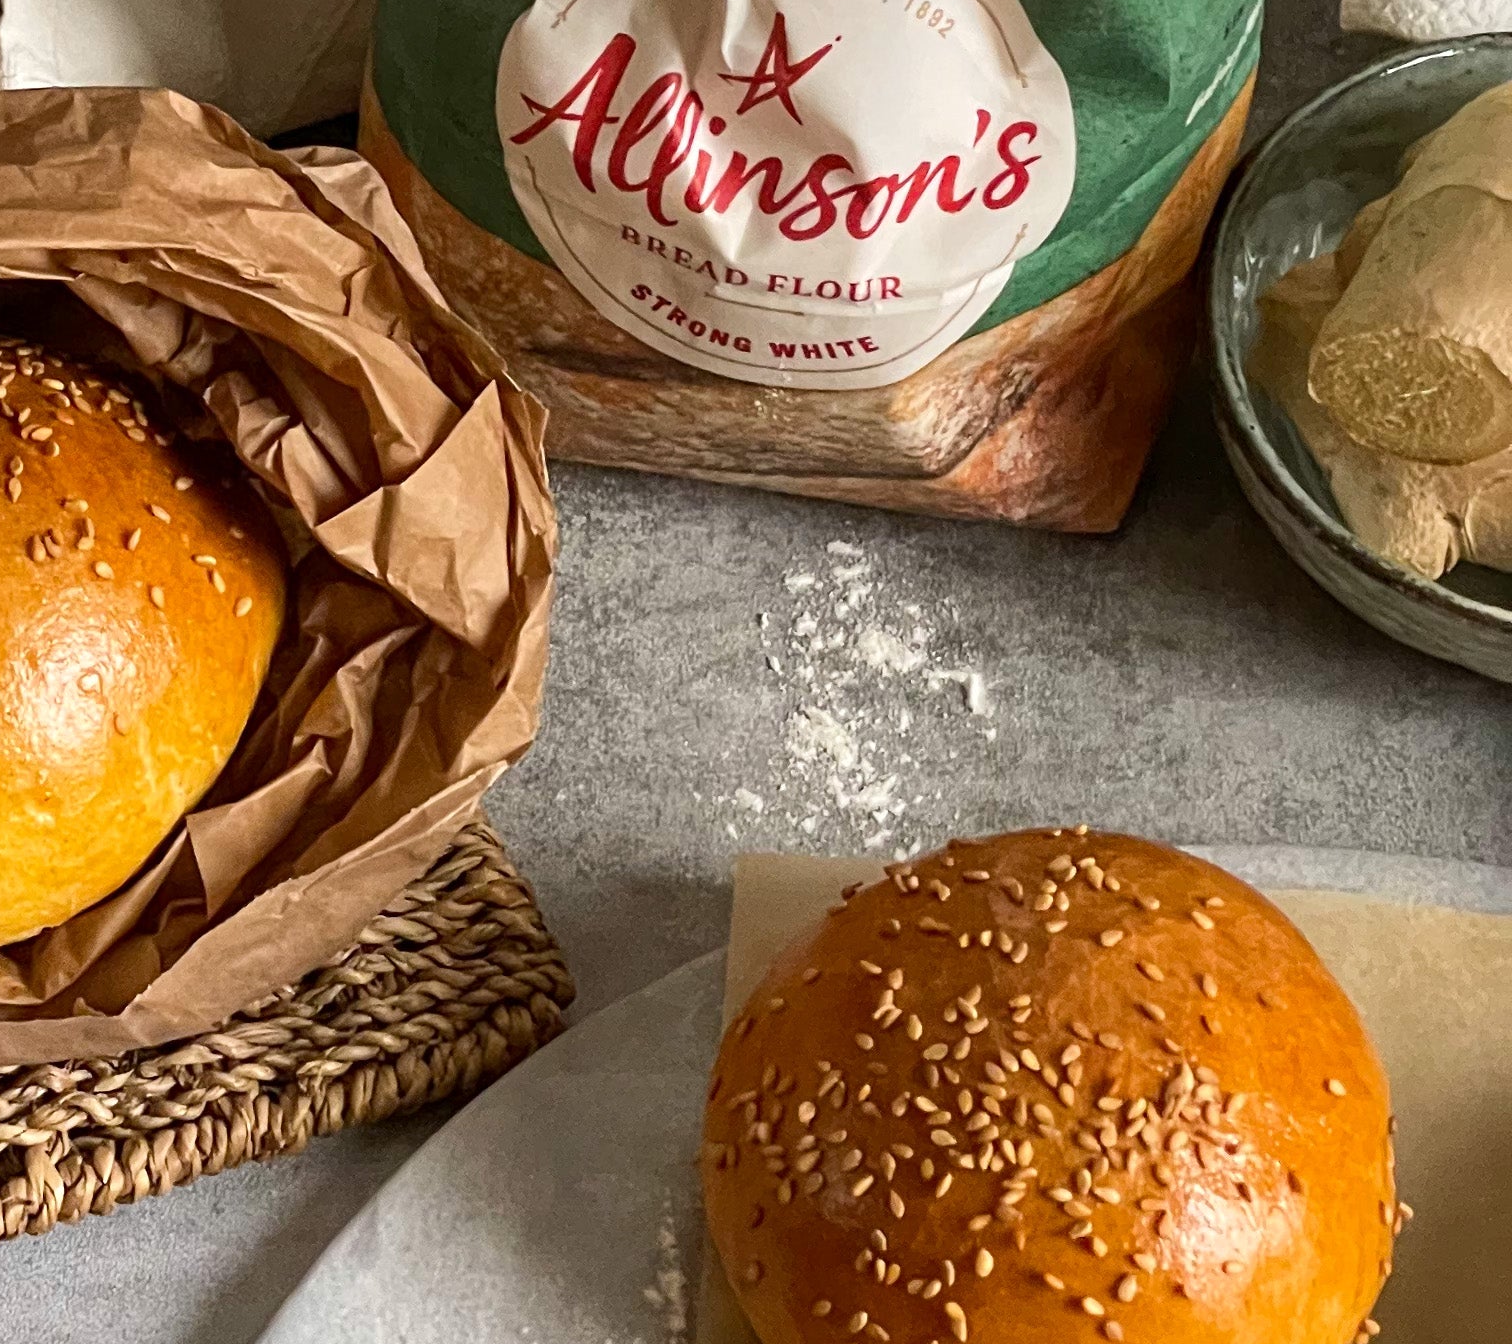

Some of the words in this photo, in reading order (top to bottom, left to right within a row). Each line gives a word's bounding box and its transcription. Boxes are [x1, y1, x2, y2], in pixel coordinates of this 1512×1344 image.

[509, 32, 1043, 243] Allinson's
[620, 223, 749, 287] BREAD
[766, 272, 904, 304] FLOUR
[629, 283, 753, 353] STRONG
[768, 335, 880, 360] WHITE
